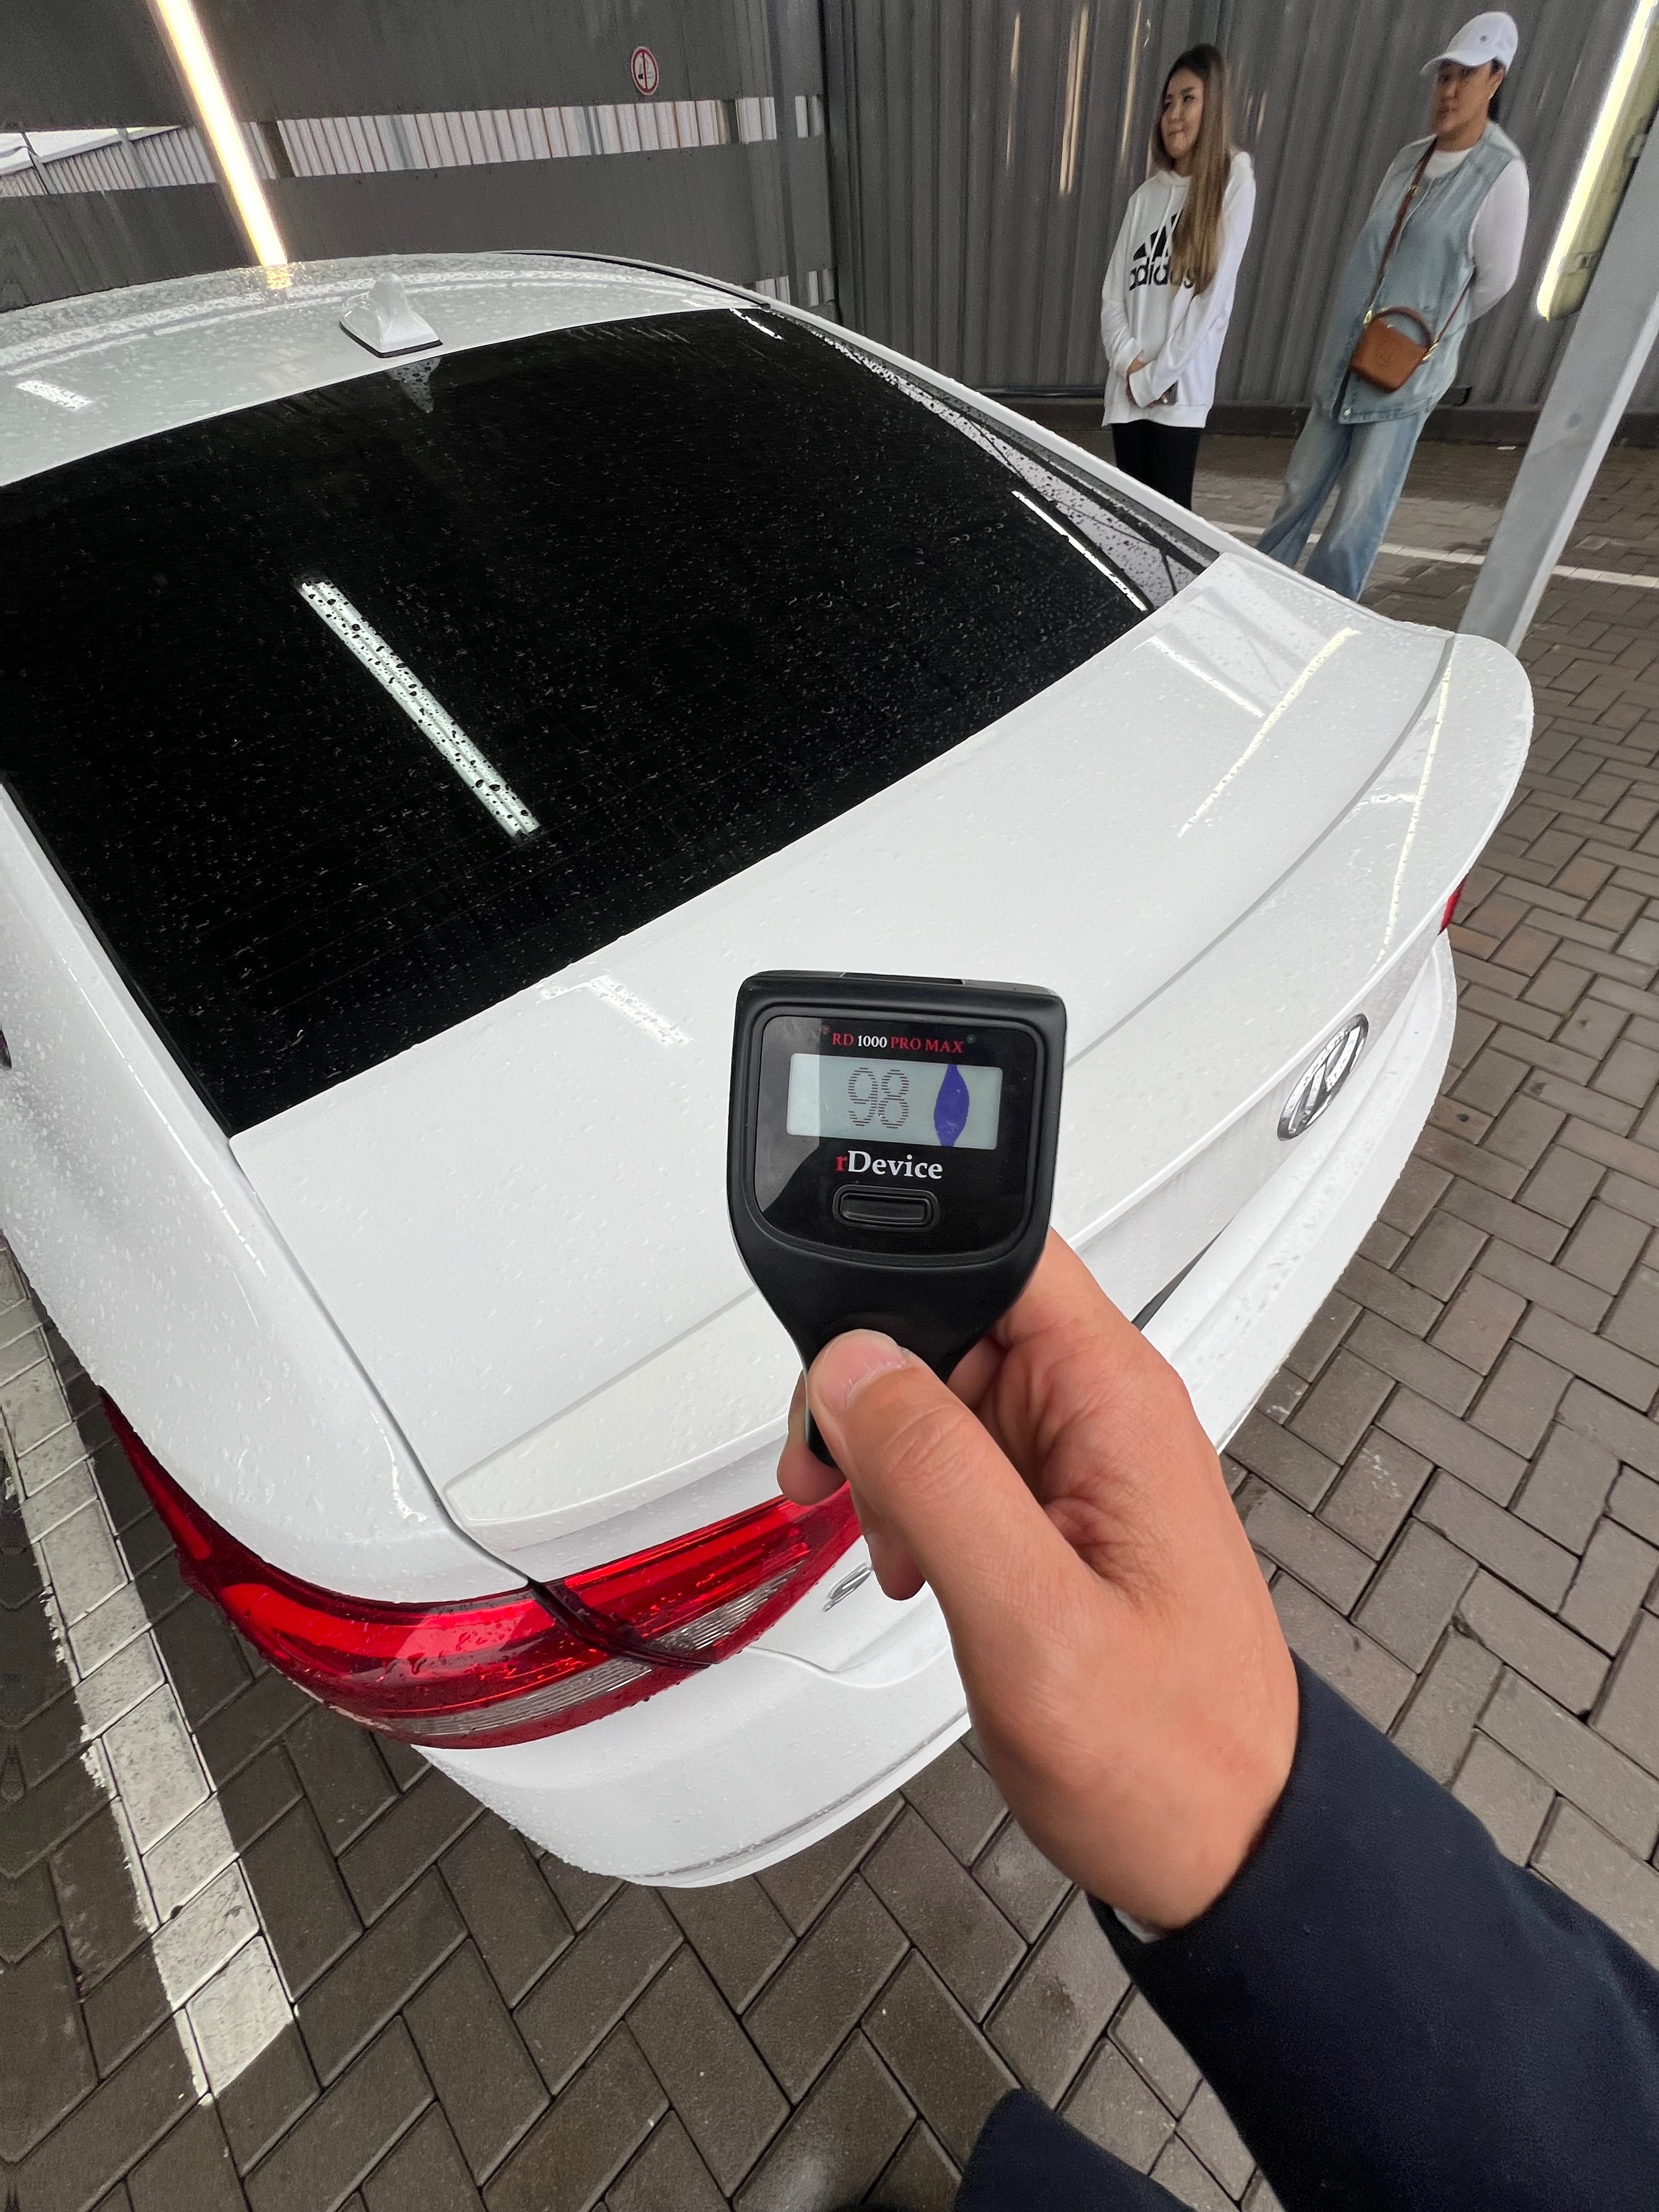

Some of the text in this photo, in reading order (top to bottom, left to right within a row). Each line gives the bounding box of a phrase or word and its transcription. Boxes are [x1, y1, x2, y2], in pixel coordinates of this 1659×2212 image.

[832, 1032, 964, 1053] RD 1000 PRO MAX
[848, 1067, 909, 1128] 98
[836, 1150, 944, 1180] rDevice
